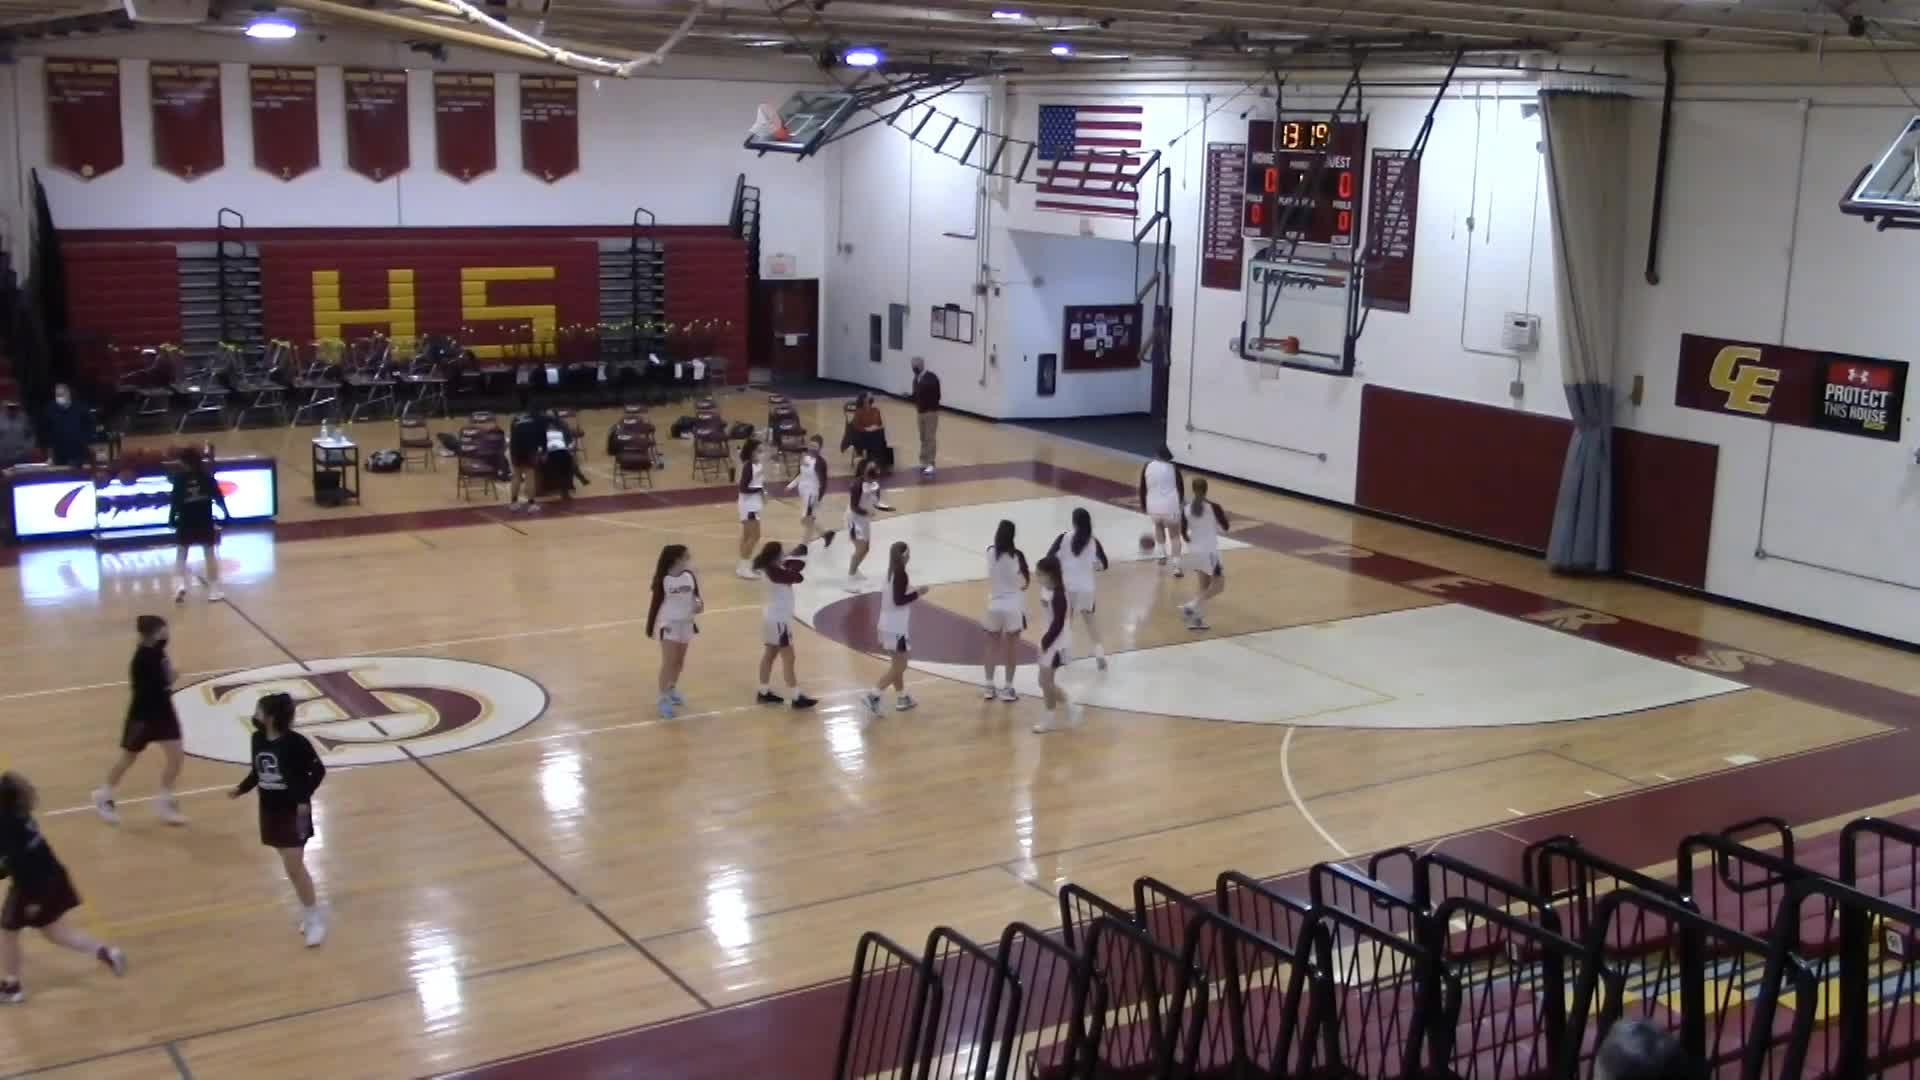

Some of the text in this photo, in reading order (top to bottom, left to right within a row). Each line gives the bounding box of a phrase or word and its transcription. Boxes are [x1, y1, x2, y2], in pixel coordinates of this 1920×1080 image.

[1252, 152, 1276, 165] HOME
[1264, 167, 1279, 193] 0
[1338, 170, 1353, 199] 0
[1251, 202, 1264, 225] 0
[1337, 210, 1352, 232] 0
[1708, 344, 1781, 416] CE
[1824, 383, 1890, 409] PROTECT
[1824, 401, 1848, 419] THIS
[1848, 405, 1887, 426] HOUSE
